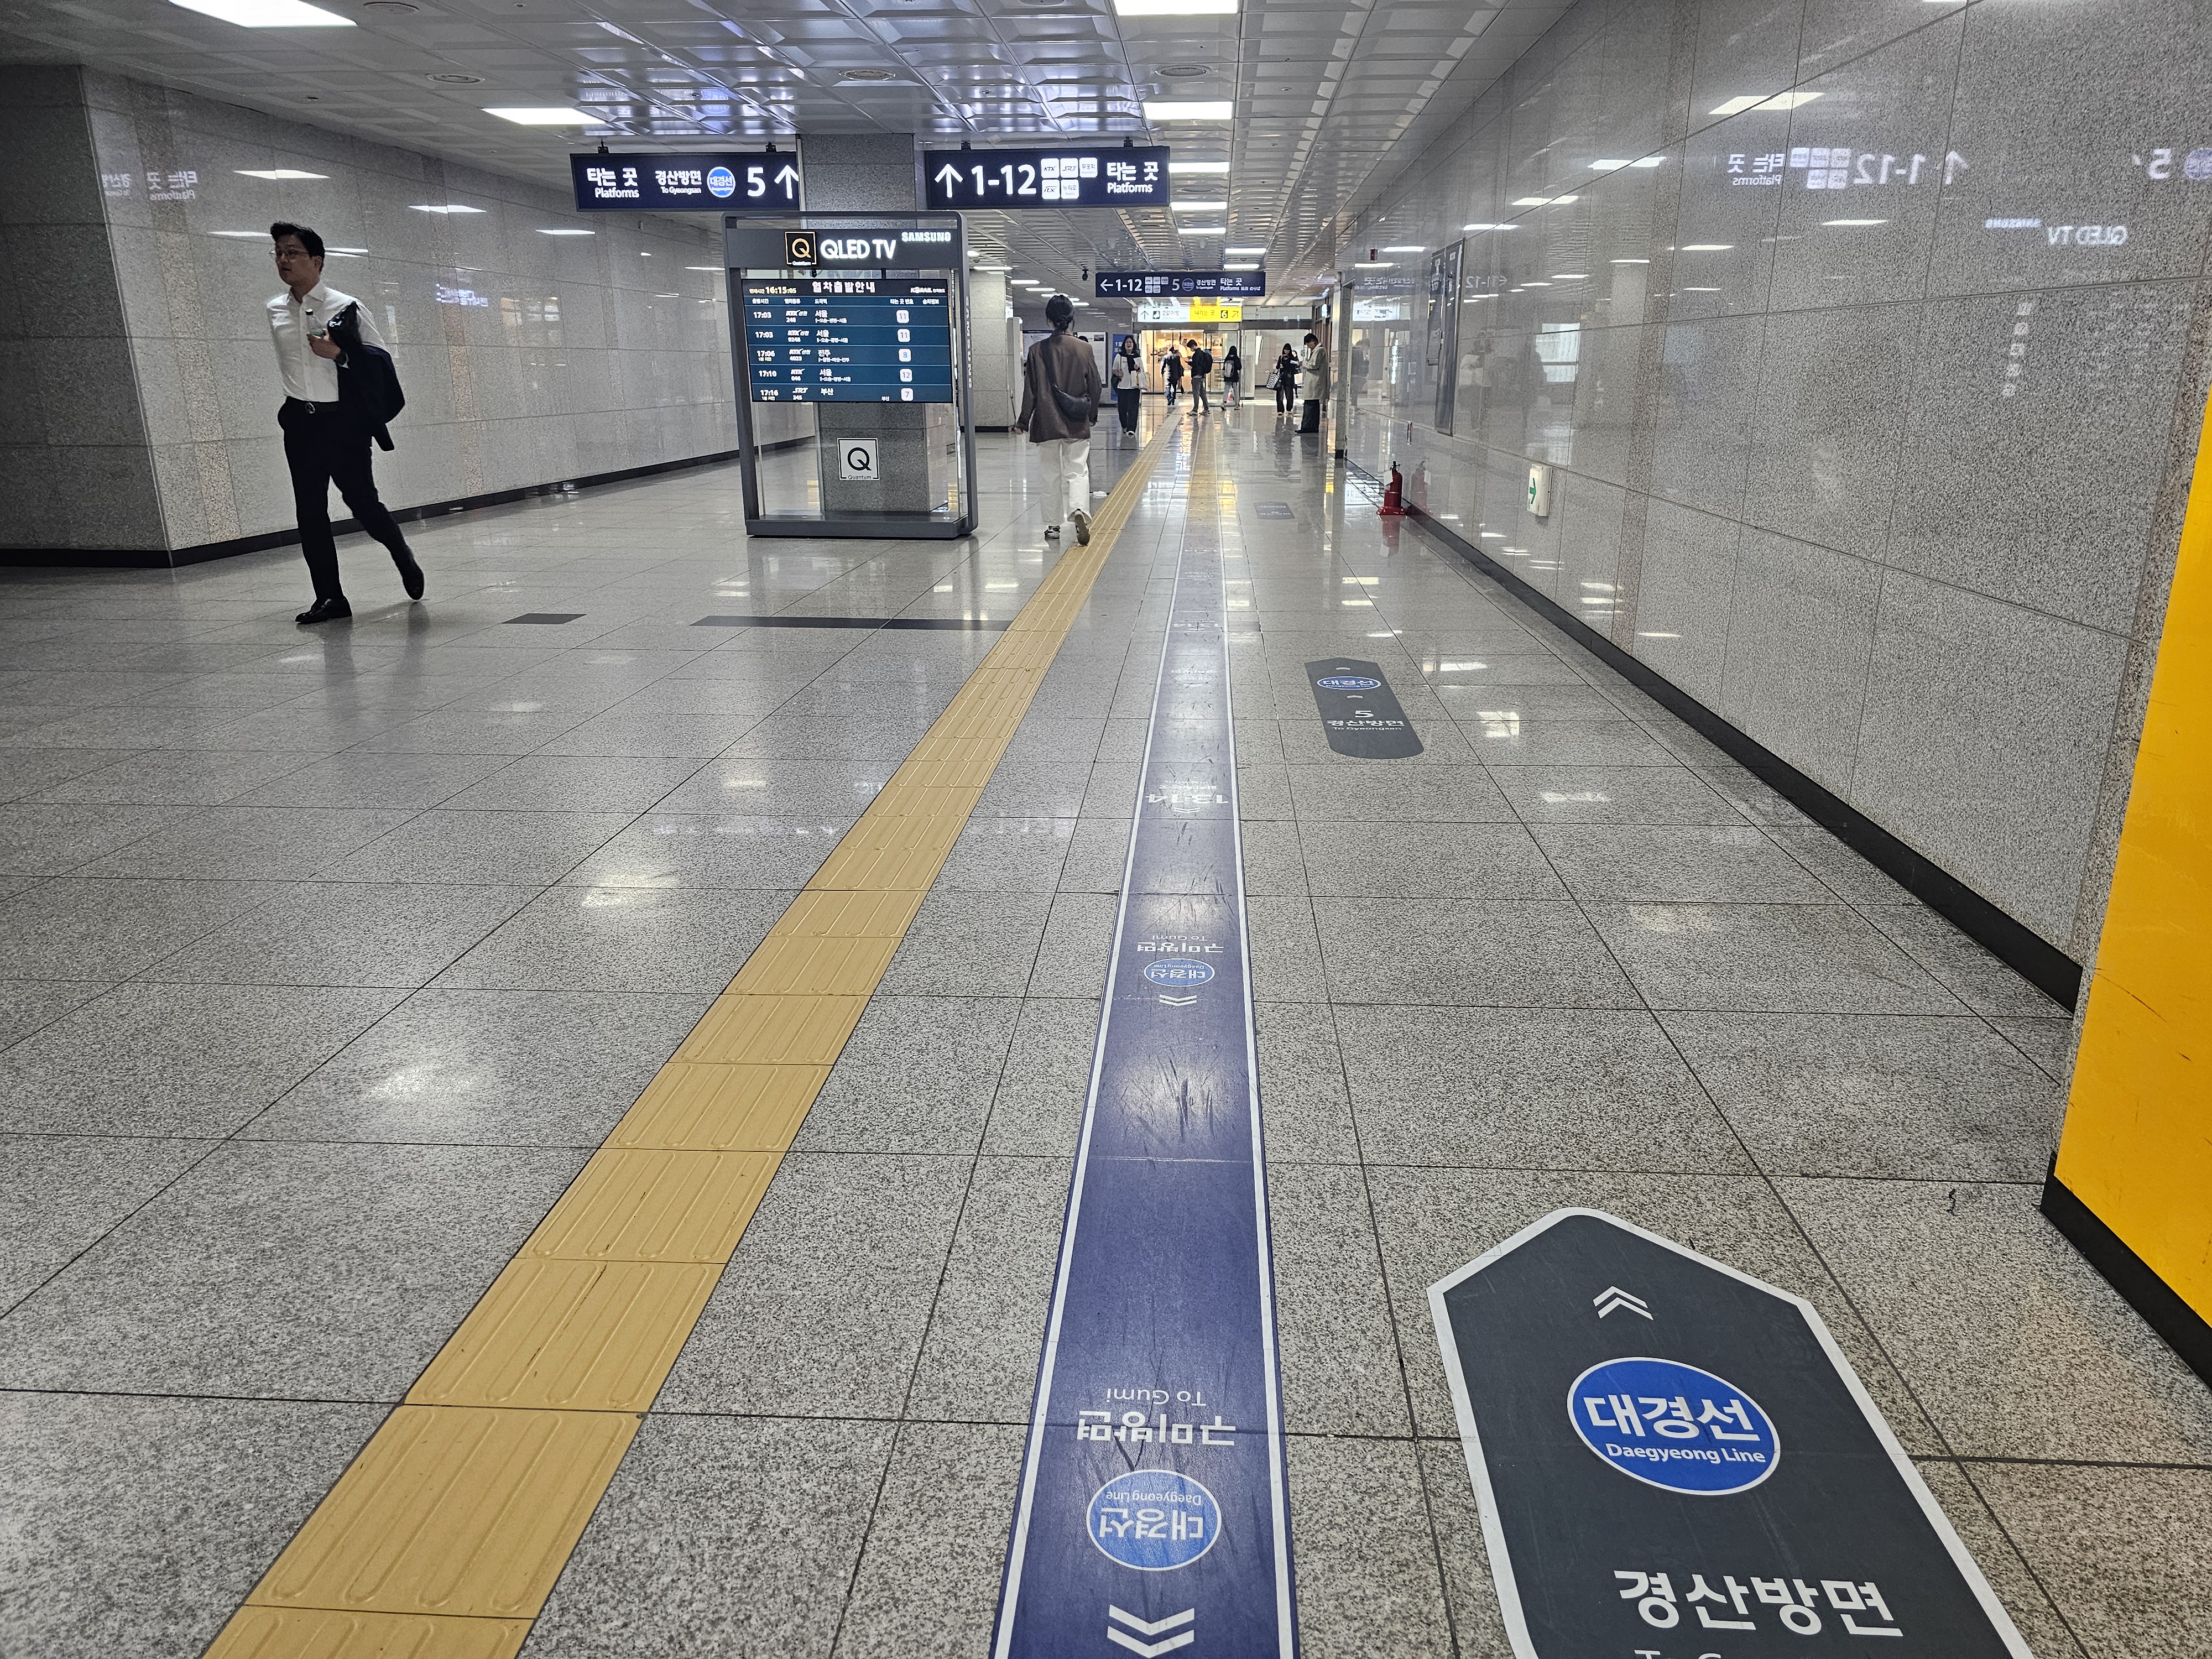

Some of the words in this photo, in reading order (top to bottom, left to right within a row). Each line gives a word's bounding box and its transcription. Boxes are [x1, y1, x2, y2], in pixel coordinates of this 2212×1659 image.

[587, 168, 616, 186] 타는
[623, 168, 638, 186] 곳
[655, 170, 702, 185] 경산방면
[1107, 162, 1136, 181] 타는
[1143, 162, 1159, 181] 곳
[709, 176, 733, 186] 대경선
[748, 167, 766, 197] 5
[971, 164, 1037, 196] 1-12
[595, 187, 640, 199] Platforms
[1108, 182, 1153, 194] Platforms
[901, 232, 951, 242] SAMSUNG
[792, 238, 812, 258] Q
[821, 239, 870, 259] QLED
[872, 239, 896, 259] TV
[1116, 279, 1142, 291] 1-12
[1172, 279, 1180, 291] 5
[816, 330, 830, 338] 서울
[820, 368, 832, 377] 서울
[848, 447, 872, 471] Q
[1137, 942, 1224, 953] 구미방면
[1151, 969, 1206, 979] 대경선
[1107, 1388, 1171, 1405] Gumi
[1177, 1391, 1207, 1406] To
[1583, 1394, 1761, 1441] 대경선
[1077, 1411, 1236, 1446] 구미방면
[1605, 1442, 1721, 1464] Daegyeong
[1725, 1447, 1766, 1463] Line
[1107, 1491, 1131, 1503] Line
[1132, 1492, 1202, 1506] Daegyeong
[1099, 1507, 1204, 1541] 대경선
[1614, 1570, 1904, 1637] 경산방면
